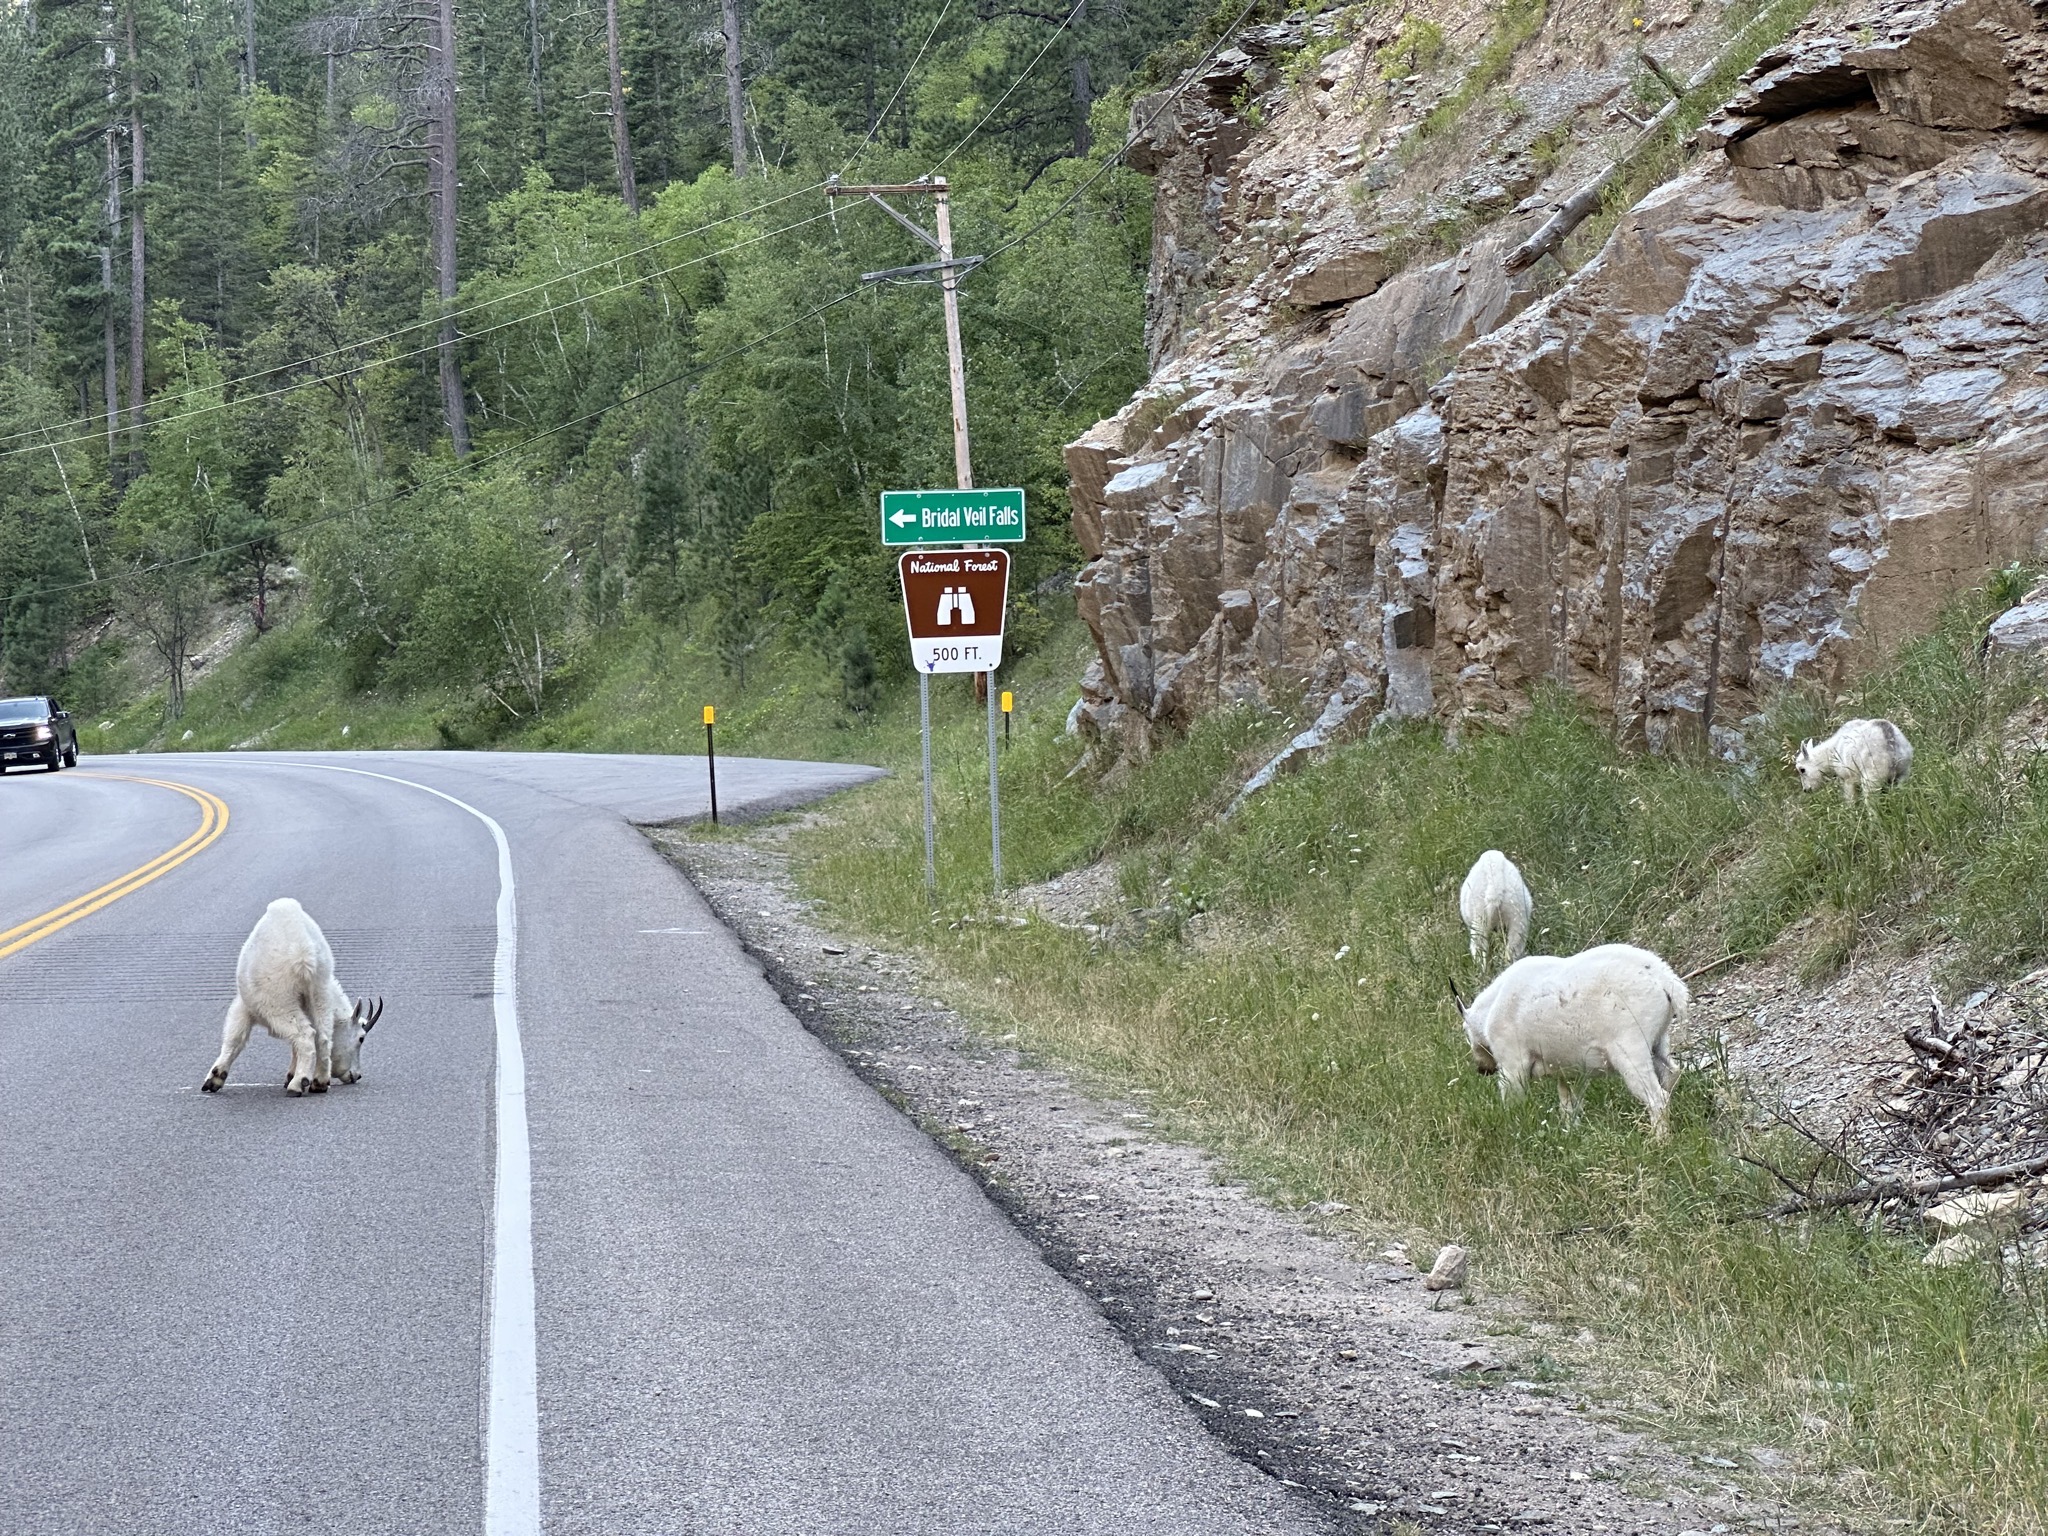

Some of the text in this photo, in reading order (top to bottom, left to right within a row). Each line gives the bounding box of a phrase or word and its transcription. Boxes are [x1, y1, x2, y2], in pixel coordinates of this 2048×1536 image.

[922, 506, 1019, 528] Bridal Veil Falls
[910, 559, 998, 574] National Forest
[933, 647, 982, 661] 500 FT.
